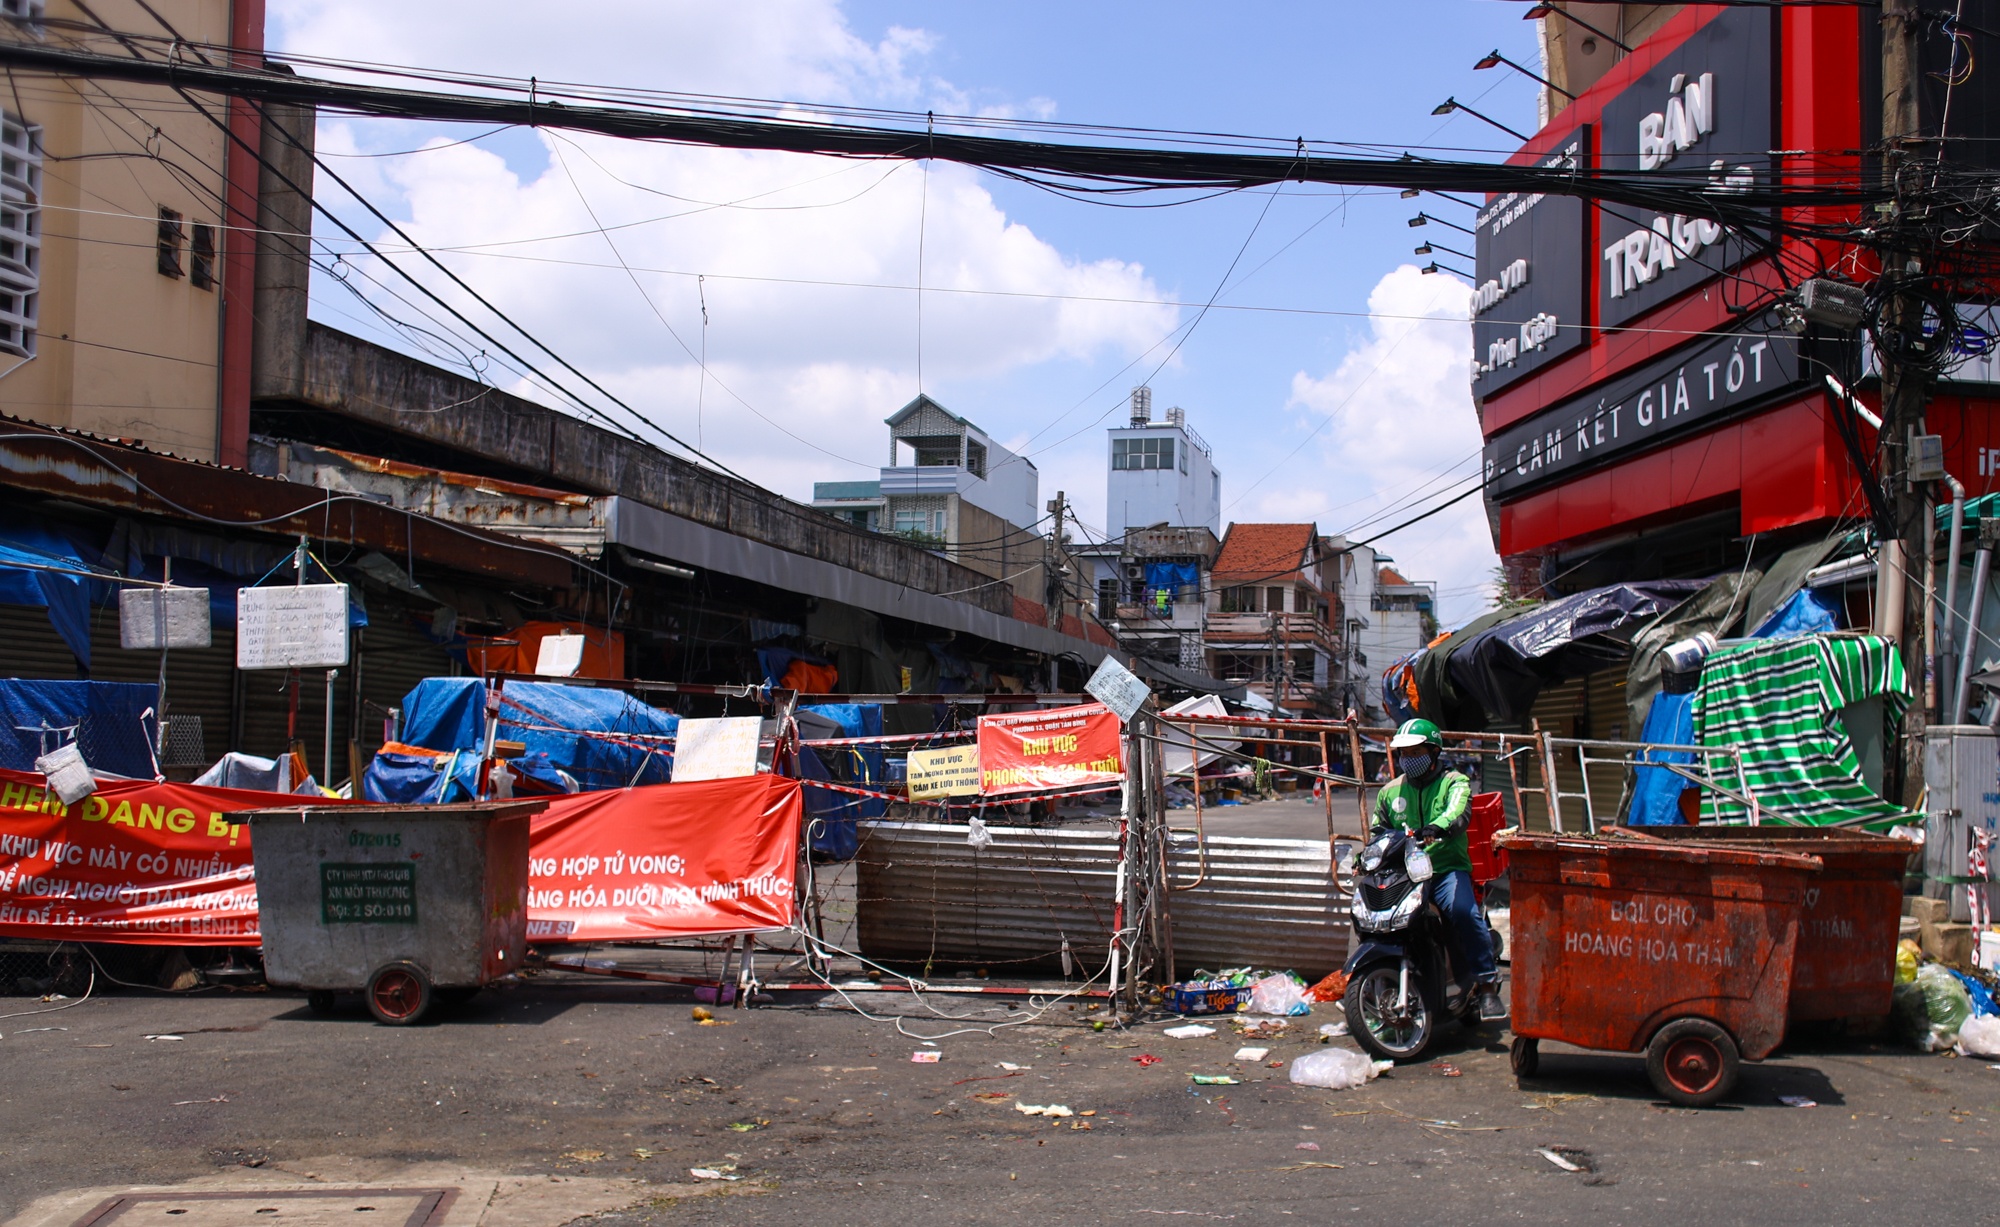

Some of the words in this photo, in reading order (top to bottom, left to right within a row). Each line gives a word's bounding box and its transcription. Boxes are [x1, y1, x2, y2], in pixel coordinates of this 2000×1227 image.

[1639, 72, 1713, 170] BÁN
[1513, 199, 1527, 220] BÁN
[1520, 312, 1558, 353] Kiện
[1577, 398, 1622, 451] KẾT
[1637, 367, 1690, 426] GIÁ
[1703, 337, 1767, 401] TỐT
[1023, 738, 1049, 756] KHU
[1052, 734, 1078, 756] VỰC
[930, 757, 946, 766] KHU
[947, 755, 963, 764] VỰC
[930, 781, 938, 790] XE
[940, 779, 953, 788] LƯU
[81, 795, 196, 834] ĐANG
[206, 811, 240, 846] BỊ
[1, 834, 40, 859] KHU
[44, 840, 83, 868] VỰC
[88, 842, 132, 870] NÀY
[136, 849, 169, 874] CÓ
[173, 851, 232, 879] NHIỀU
[561, 854, 600, 881] HỢP
[603, 850, 627, 875] TỬ
[628, 854, 686, 877] VONG;
[17, 874, 70, 902] NGHỊ
[73, 880, 140, 905] NGƯỜI
[145, 887, 189, 911] DÂN
[192, 891, 259, 915] KHÔNG
[568, 884, 608, 908] HÓA
[613, 885, 658, 907] DƯỚI
[701, 880, 740, 904] HÌNH
[742, 871, 794, 902] THỨC;
[1802, 886, 1820, 909] Ợ
[353, 904, 361, 917] 2
[1811, 914, 1854, 939] THÁM
[1638, 939, 1680, 963] HOA
[1206, 991, 1237, 1011] Tiger
